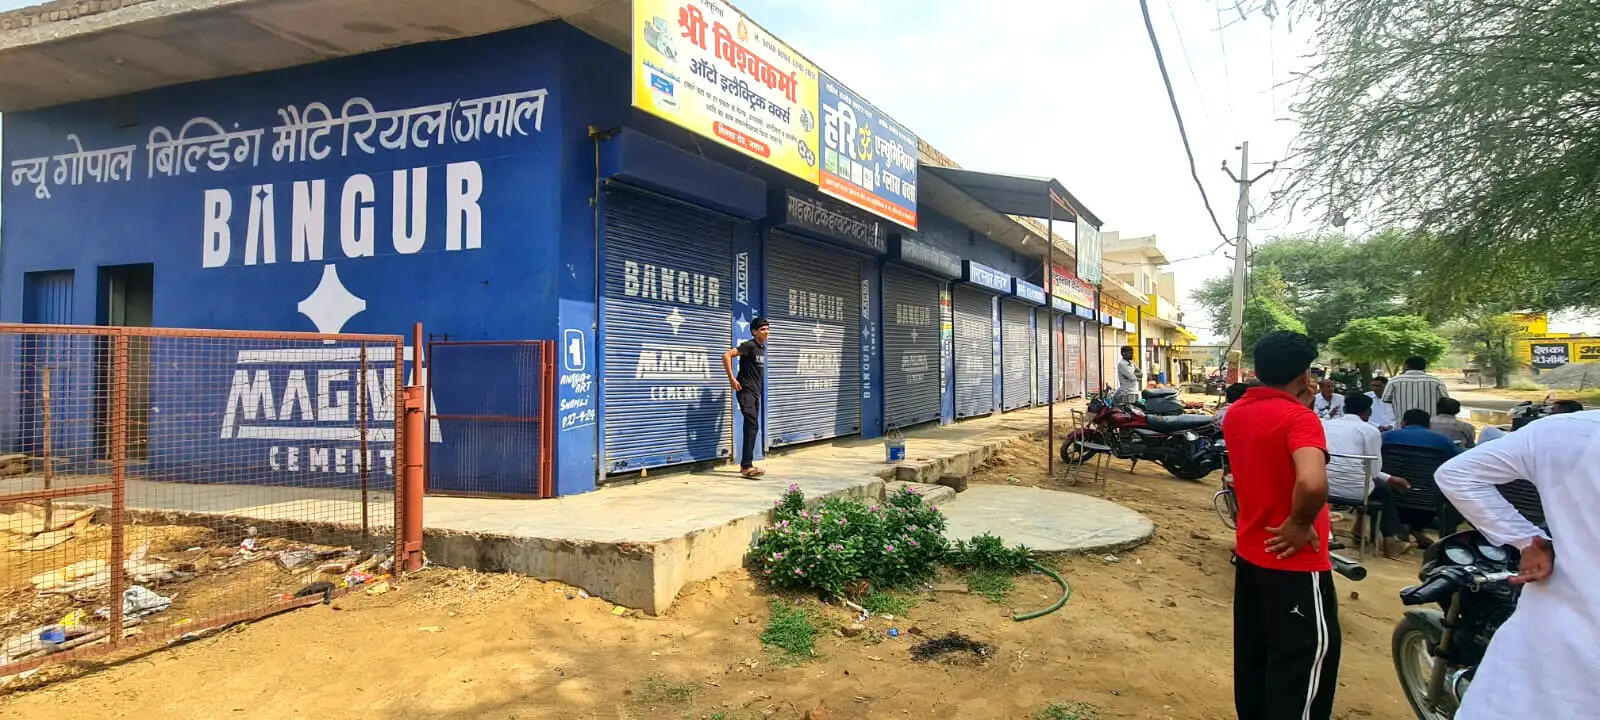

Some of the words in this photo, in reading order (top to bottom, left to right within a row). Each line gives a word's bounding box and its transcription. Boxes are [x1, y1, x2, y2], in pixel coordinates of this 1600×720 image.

[677, 4, 708, 50] श्री
[712, 21, 798, 104] विश्वकर्मा
[690, 57, 717, 85] ऑटो
[823, 101, 857, 160] हरि
[11, 157, 51, 199] न्यू
[53, 133, 136, 185] गोपाल
[146, 117, 264, 178] बिल्डिंग
[874, 162, 880, 187] &
[203, 160, 483, 268] BANGUR
[624, 260, 720, 307] BANGUR
[736, 252, 749, 305] MAGNA
[862, 280, 870, 320] MAGNA
[789, 289, 844, 321] BANGUR
[635, 349, 712, 379] MAGNA
[863, 345, 871, 398] BANGUR
[651, 386, 699, 400] CEMENT
[269, 446, 396, 475] CEMENT
